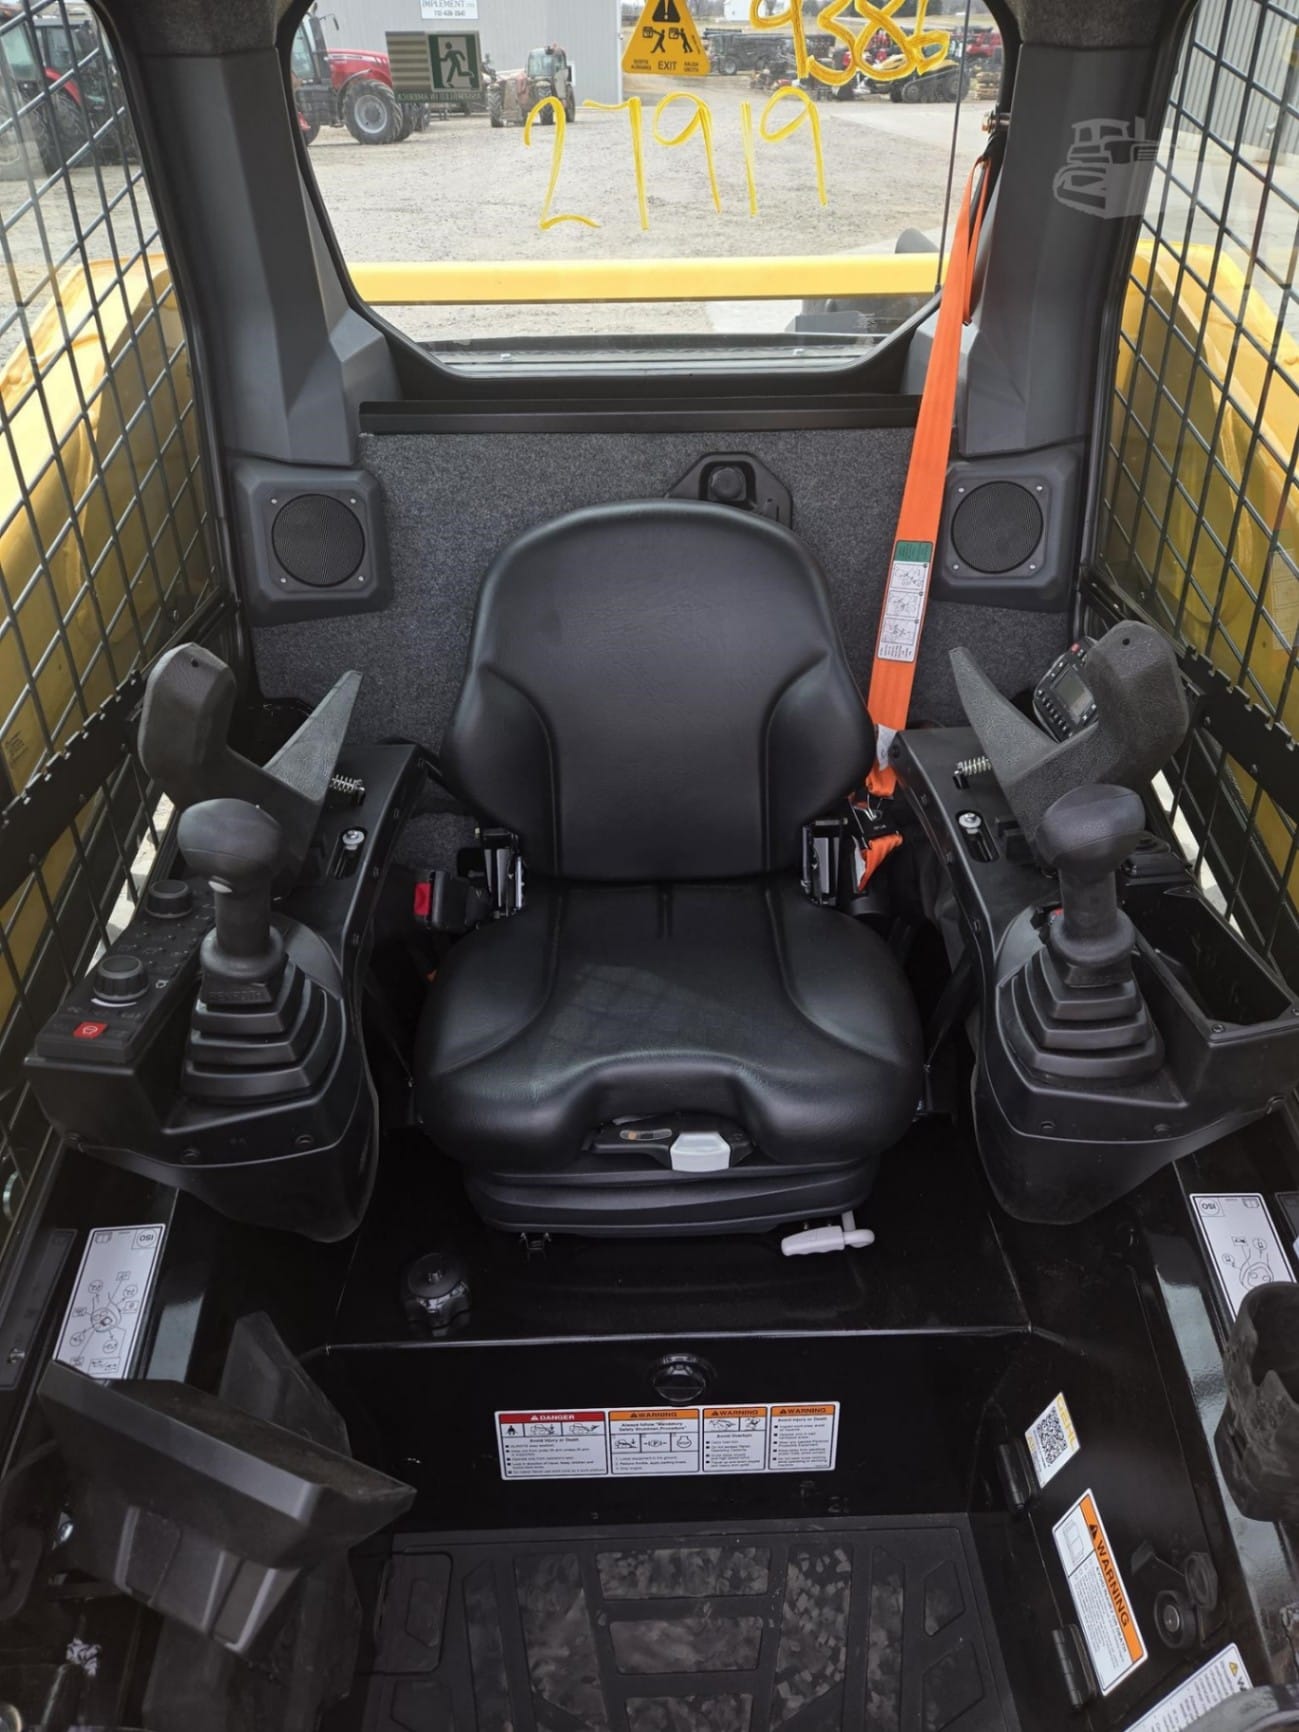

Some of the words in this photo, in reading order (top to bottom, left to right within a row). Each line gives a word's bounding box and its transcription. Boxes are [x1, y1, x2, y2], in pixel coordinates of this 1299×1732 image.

[658, 61, 677, 70] EXIT
[524, 86, 828, 231] 27919
[1097, 1539, 1130, 1627] WARNING
